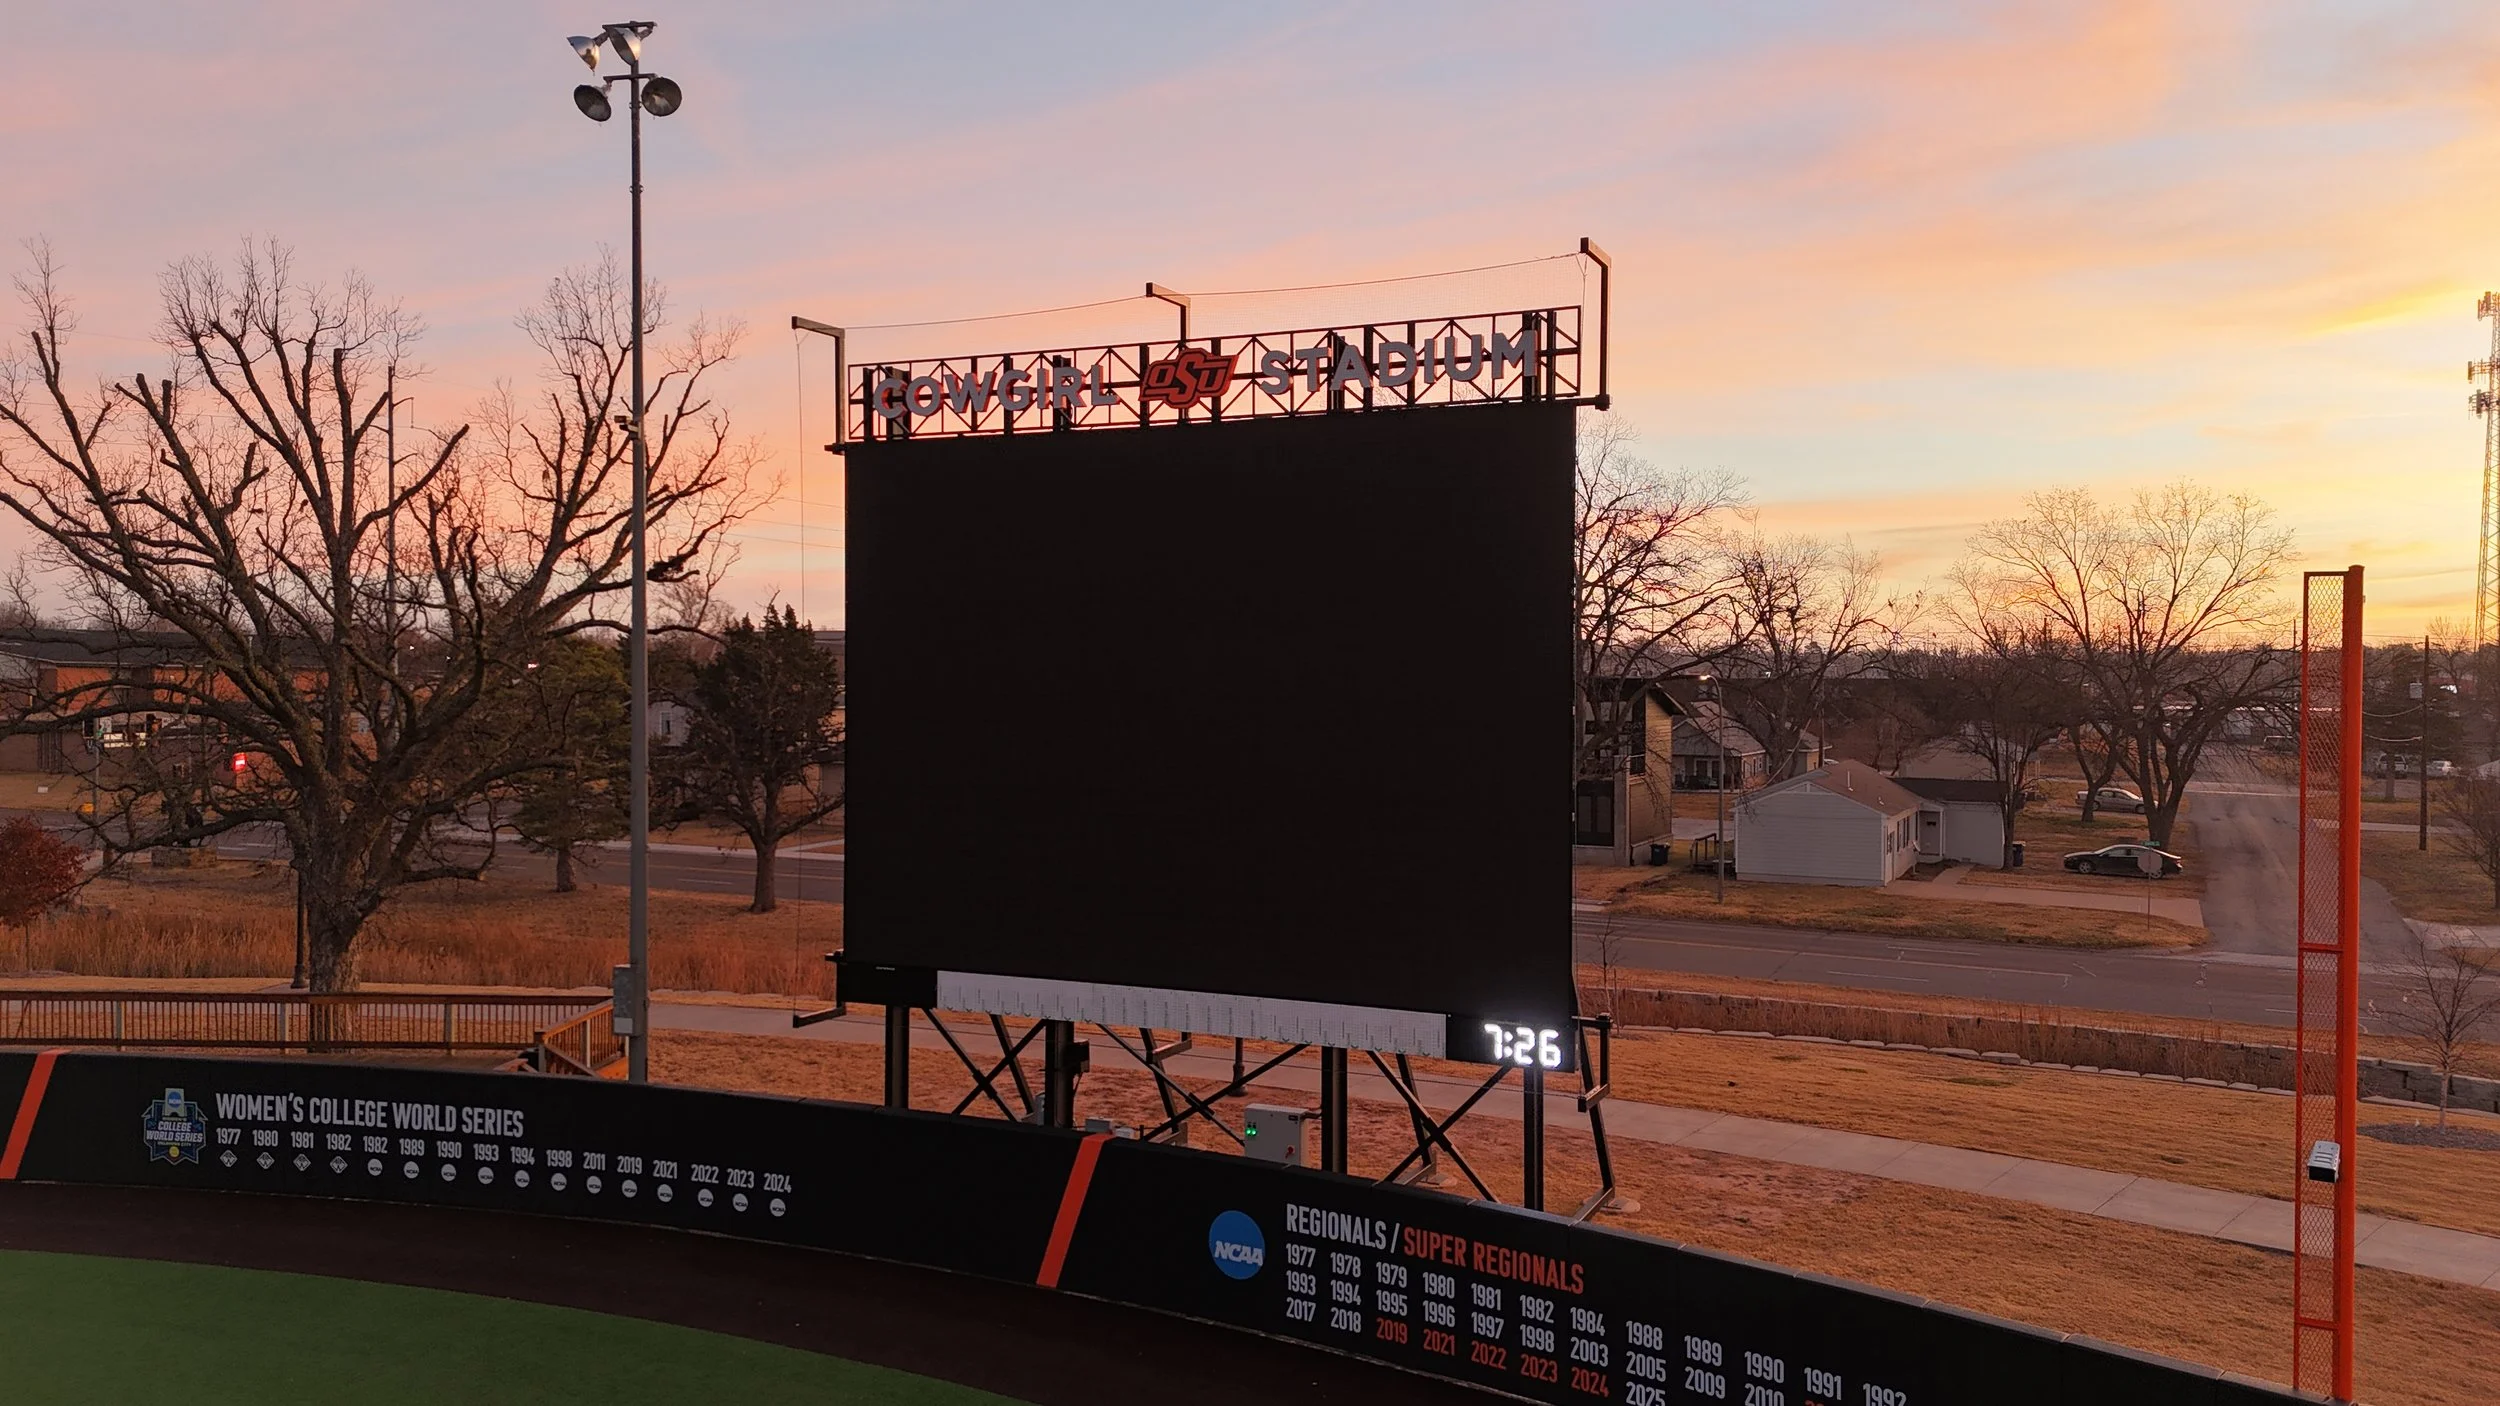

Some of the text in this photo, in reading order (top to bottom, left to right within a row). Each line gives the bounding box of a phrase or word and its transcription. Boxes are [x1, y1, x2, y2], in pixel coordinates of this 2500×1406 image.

[872, 329, 1539, 419] COWGIRL OSU STADIUM
[1483, 1022, 1562, 1068] 7:26
[146, 1130, 203, 1142] WORLD SERIES
[157, 1121, 192, 1132] COLLEGE
[215, 1092, 524, 1138] WOMEN'S COLLEGE WORLD SERIES
[215, 1127, 792, 1194] 1977 1980 1981 1982 1982 1989 1990 1993 1994 1998 2011 2019 2021 2022 2023 2024
[1214, 1240, 1264, 1267] NCAA
[1286, 1203, 1387, 1250] REGIONALS
[1403, 1226, 1467, 1267] SUPER
[1473, 1241, 1584, 1295] REGIONALS
[1285, 1242, 1907, 1406] 1977 1978 1979 1980 1981 1982 1984 1988 1989 1990 1991 1992
[1286, 1269, 1785, 1406] 1993 1994 1995 1996 1997 1998 2003 2005 2009 2010
[1286, 1296, 1666, 1406] 2017 2018 2019 2021 2022 2023 2024 2025
